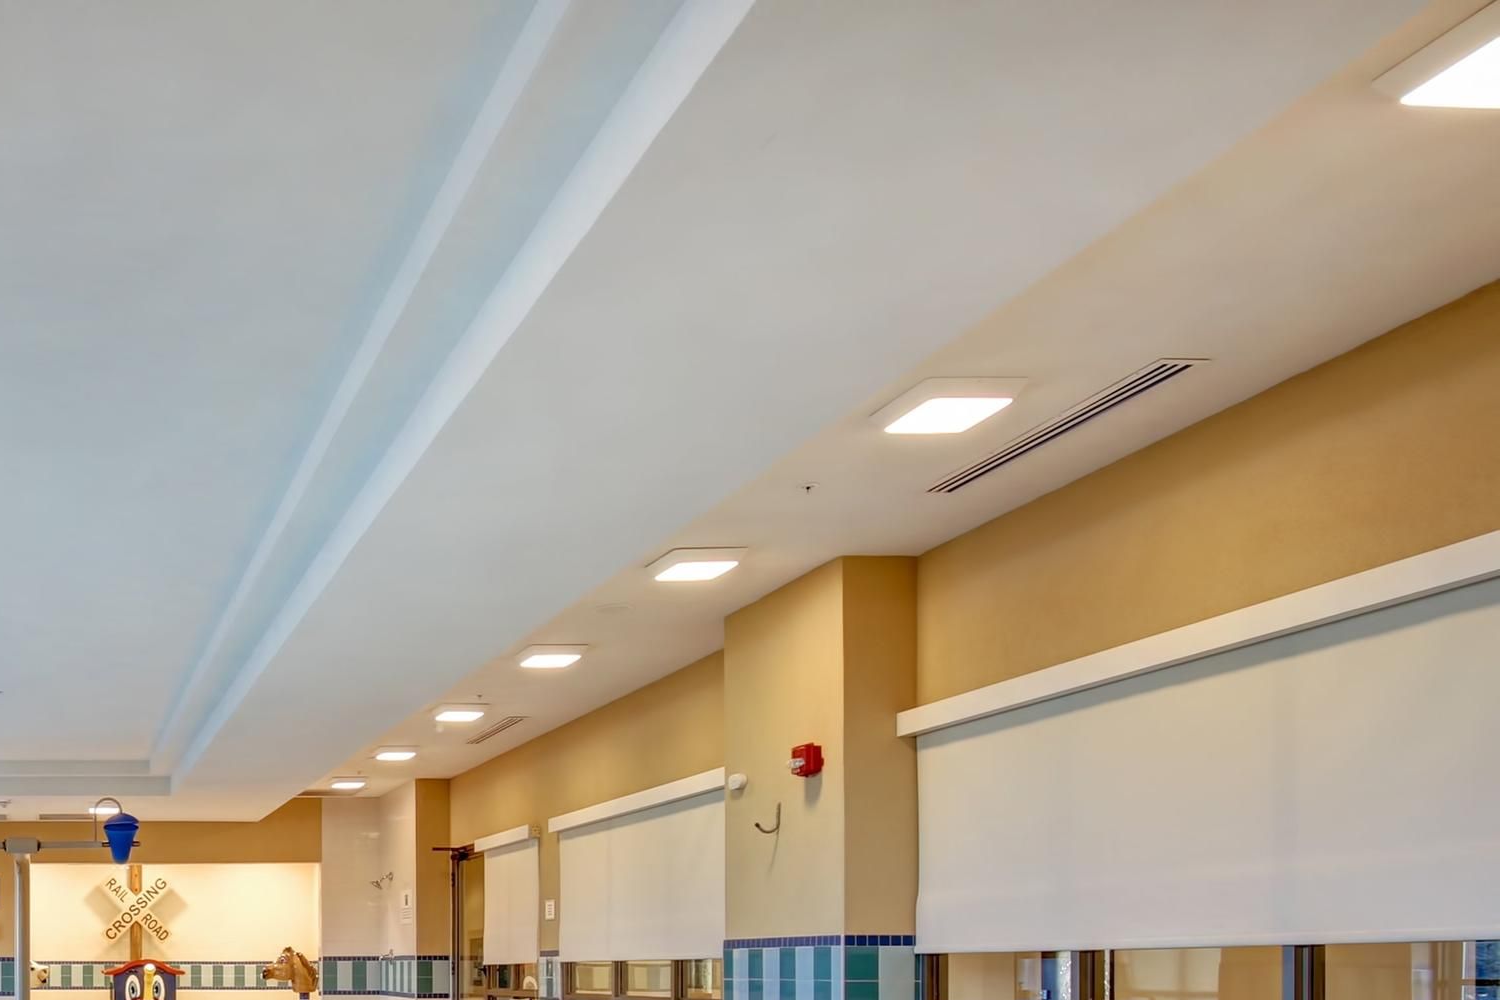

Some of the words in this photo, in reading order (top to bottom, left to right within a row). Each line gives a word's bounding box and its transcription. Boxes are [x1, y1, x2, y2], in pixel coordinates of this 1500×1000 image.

[105, 878, 167, 940] CROSSING
[105, 878, 128, 903] RAIL
[141, 913, 169, 941] ROAD
